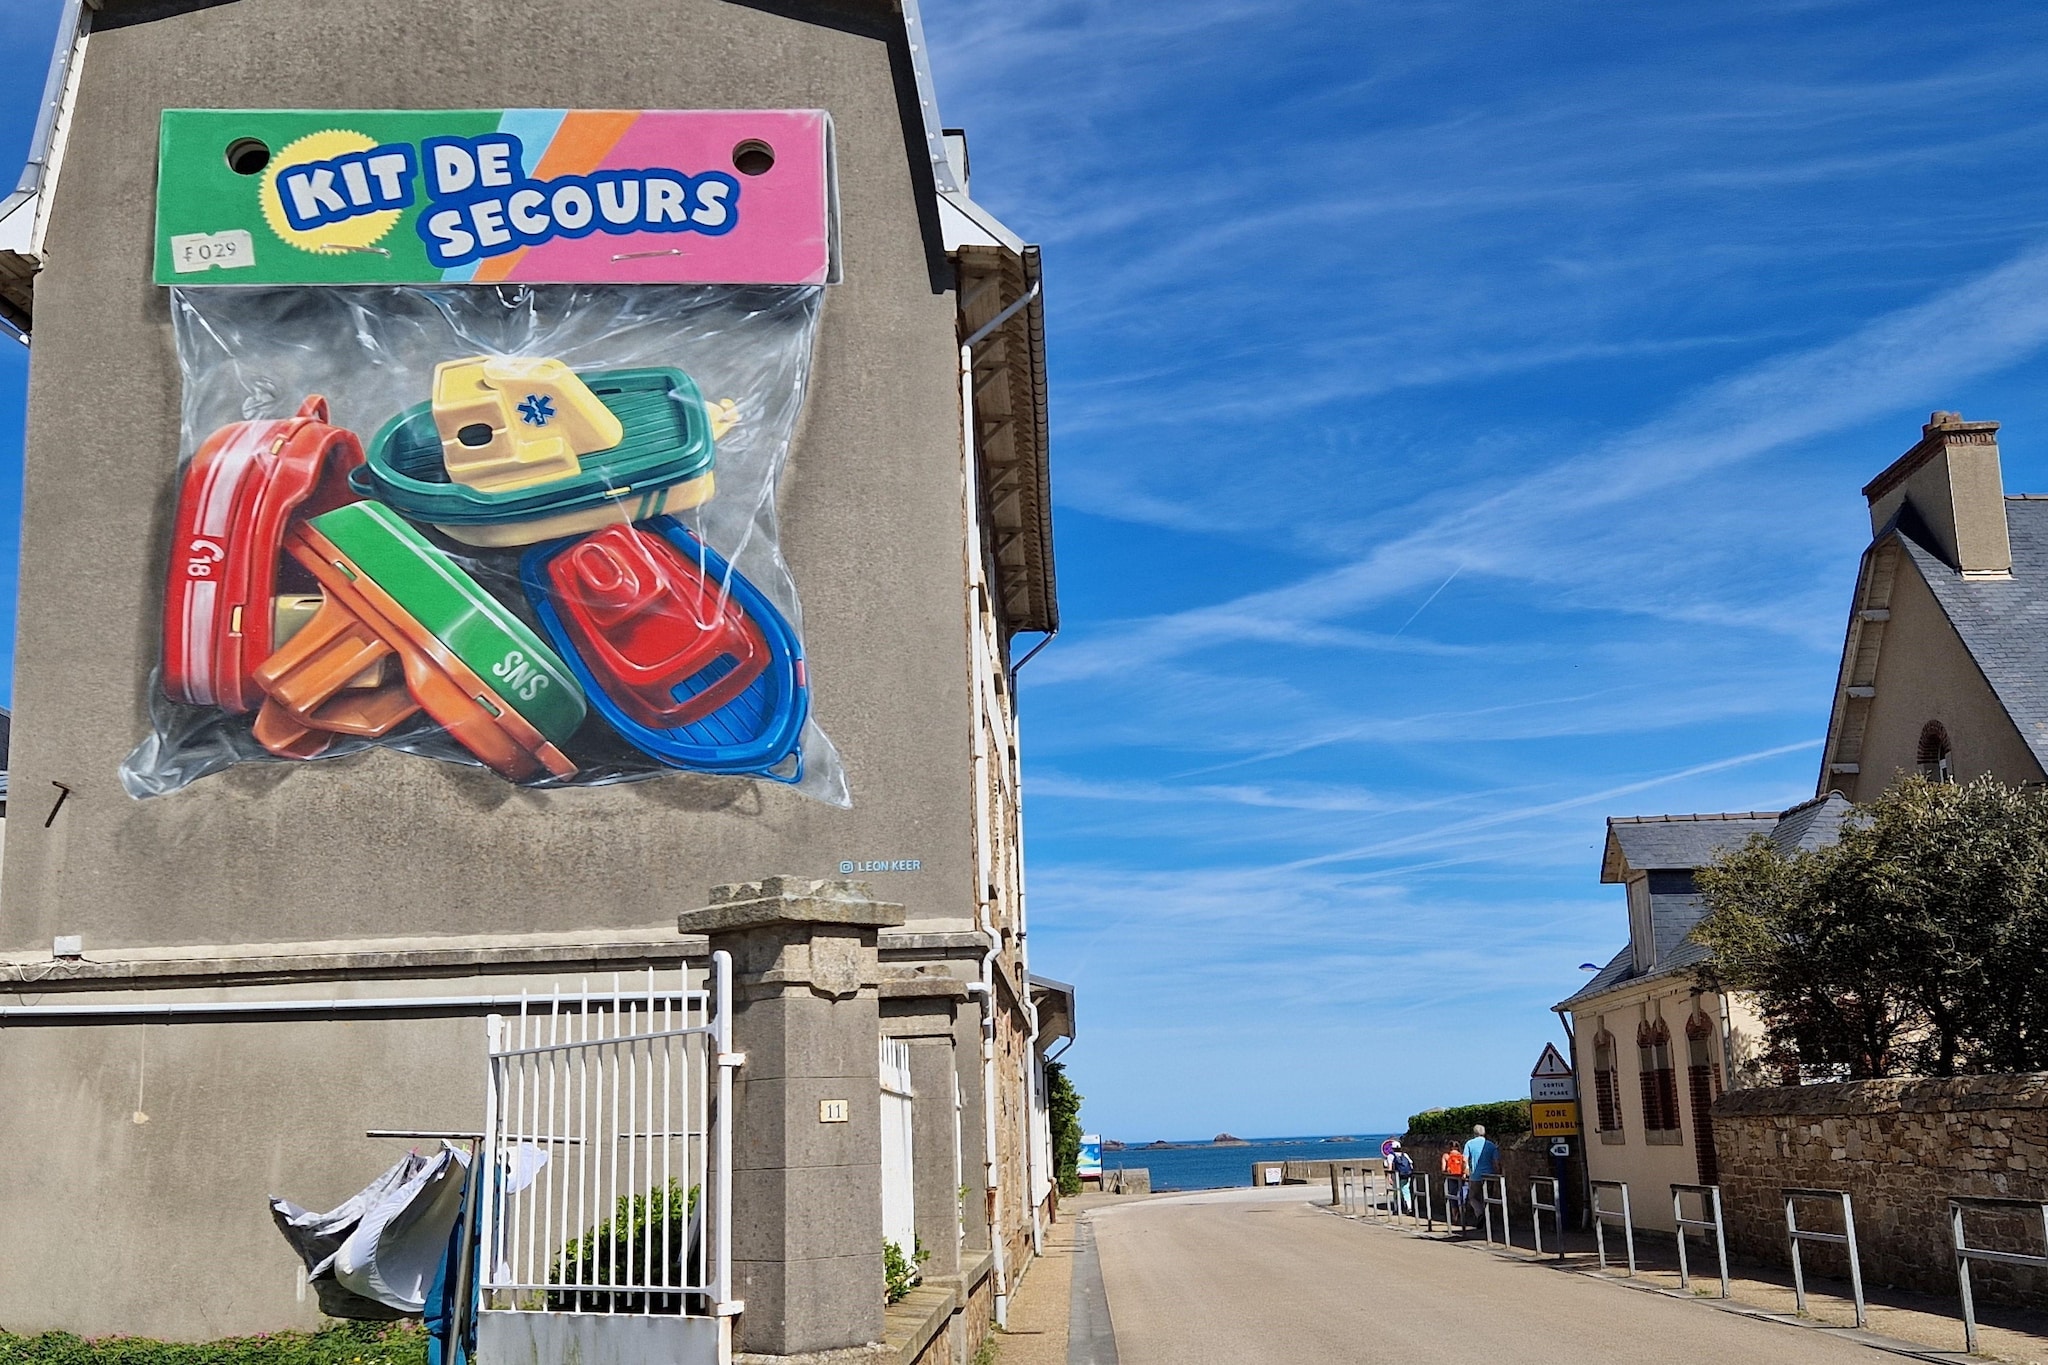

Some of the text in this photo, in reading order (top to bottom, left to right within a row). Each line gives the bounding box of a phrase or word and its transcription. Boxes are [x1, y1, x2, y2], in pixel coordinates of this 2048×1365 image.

[286, 142, 513, 220] KIT DE
[427, 179, 730, 259] SECOURS
[492, 650, 550, 701] SNS
[857, 859, 921, 872] LEON KEER
[827, 1103, 841, 1119] 11
[1545, 1109, 1567, 1118] ZONE
